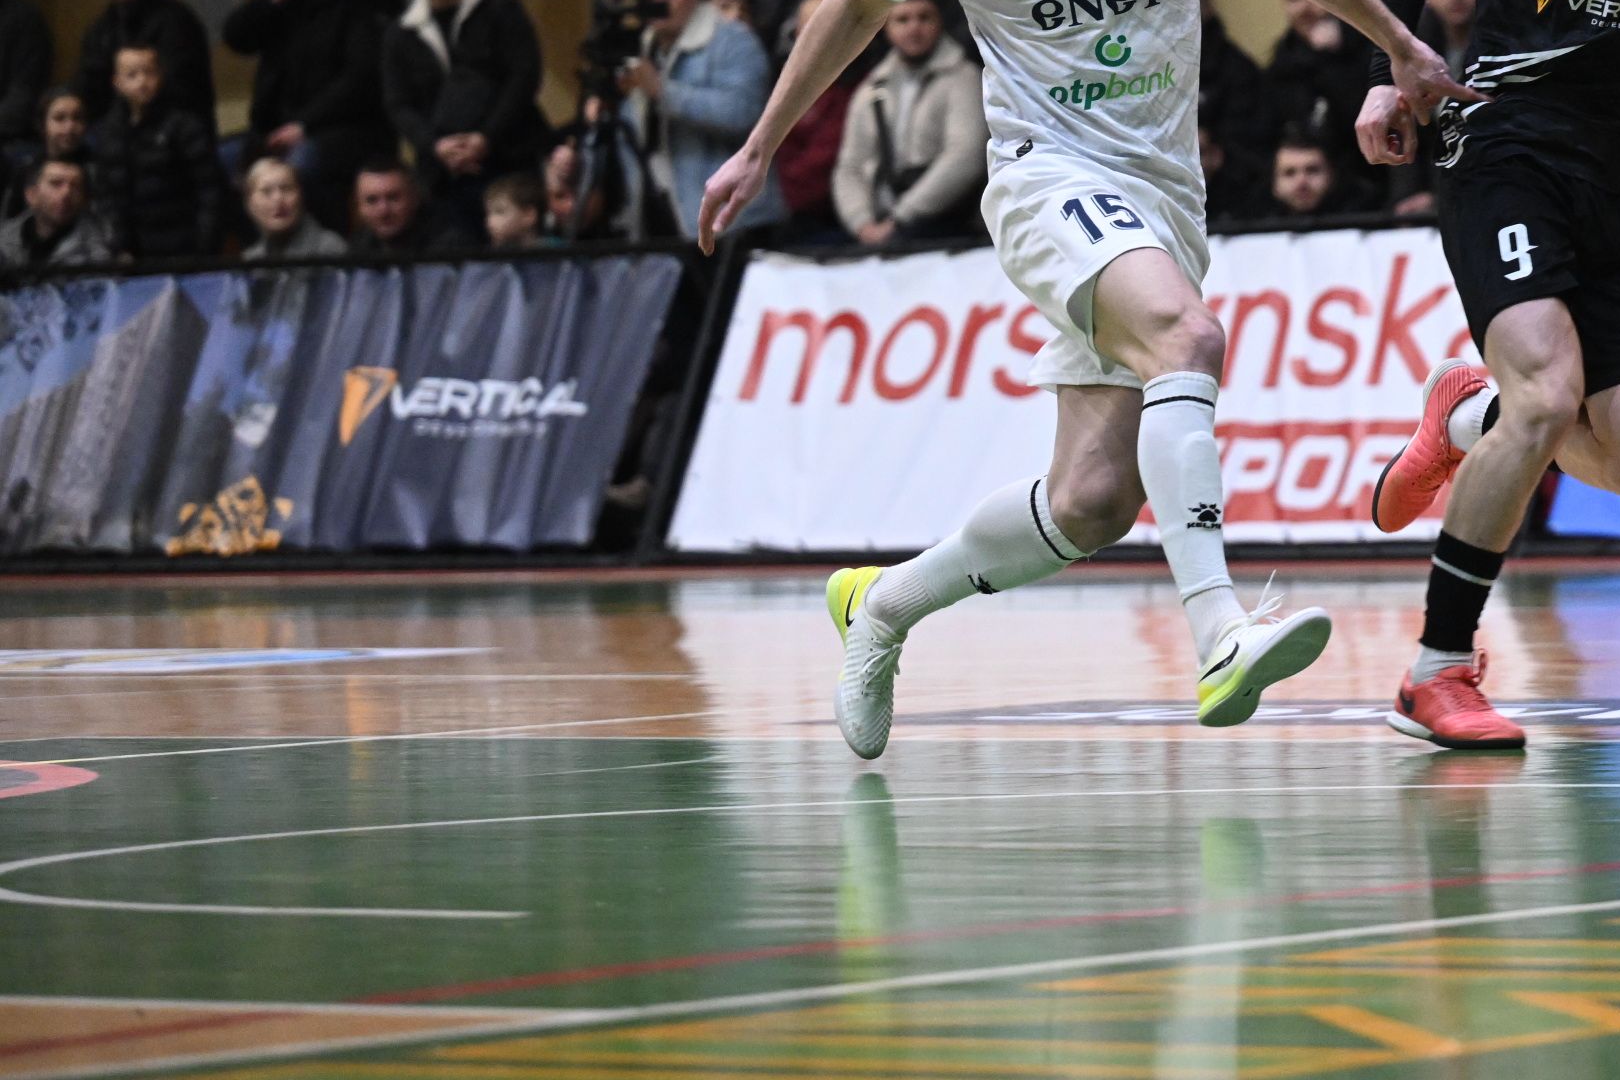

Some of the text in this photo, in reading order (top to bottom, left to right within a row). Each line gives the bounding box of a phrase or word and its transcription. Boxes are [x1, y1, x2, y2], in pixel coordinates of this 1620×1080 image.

[1049, 61, 1177, 110] otpbank
[1061, 194, 1145, 245] 15
[1498, 223, 1538, 281] 9
[739, 254, 1492, 402] morsnsk
[391, 376, 588, 421] VERTICAL
